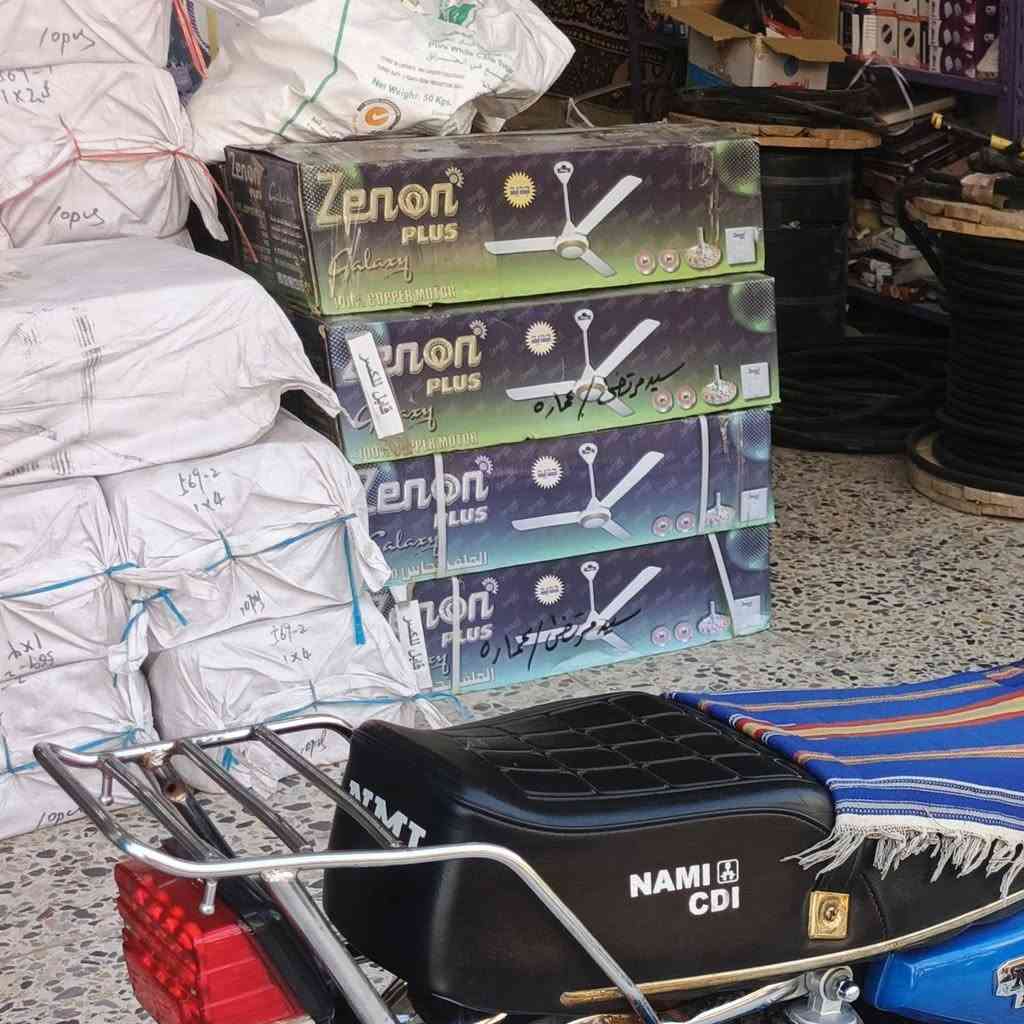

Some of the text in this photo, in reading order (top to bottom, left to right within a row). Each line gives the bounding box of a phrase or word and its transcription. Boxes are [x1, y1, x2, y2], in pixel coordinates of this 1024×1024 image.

[316, 171, 459, 226] Zenon
[401, 223, 459, 245] PLUS
[328, 246, 414, 284] Galaxy
[343, 336, 482, 383] enon
[426, 372, 481, 397] PLUS
[419, 591, 495, 630] non
[441, 624, 493, 648] PUS
[37, 807, 81, 829] 10pc
[629, 863, 711, 898] NAMI
[688, 886, 740, 916] CDI
